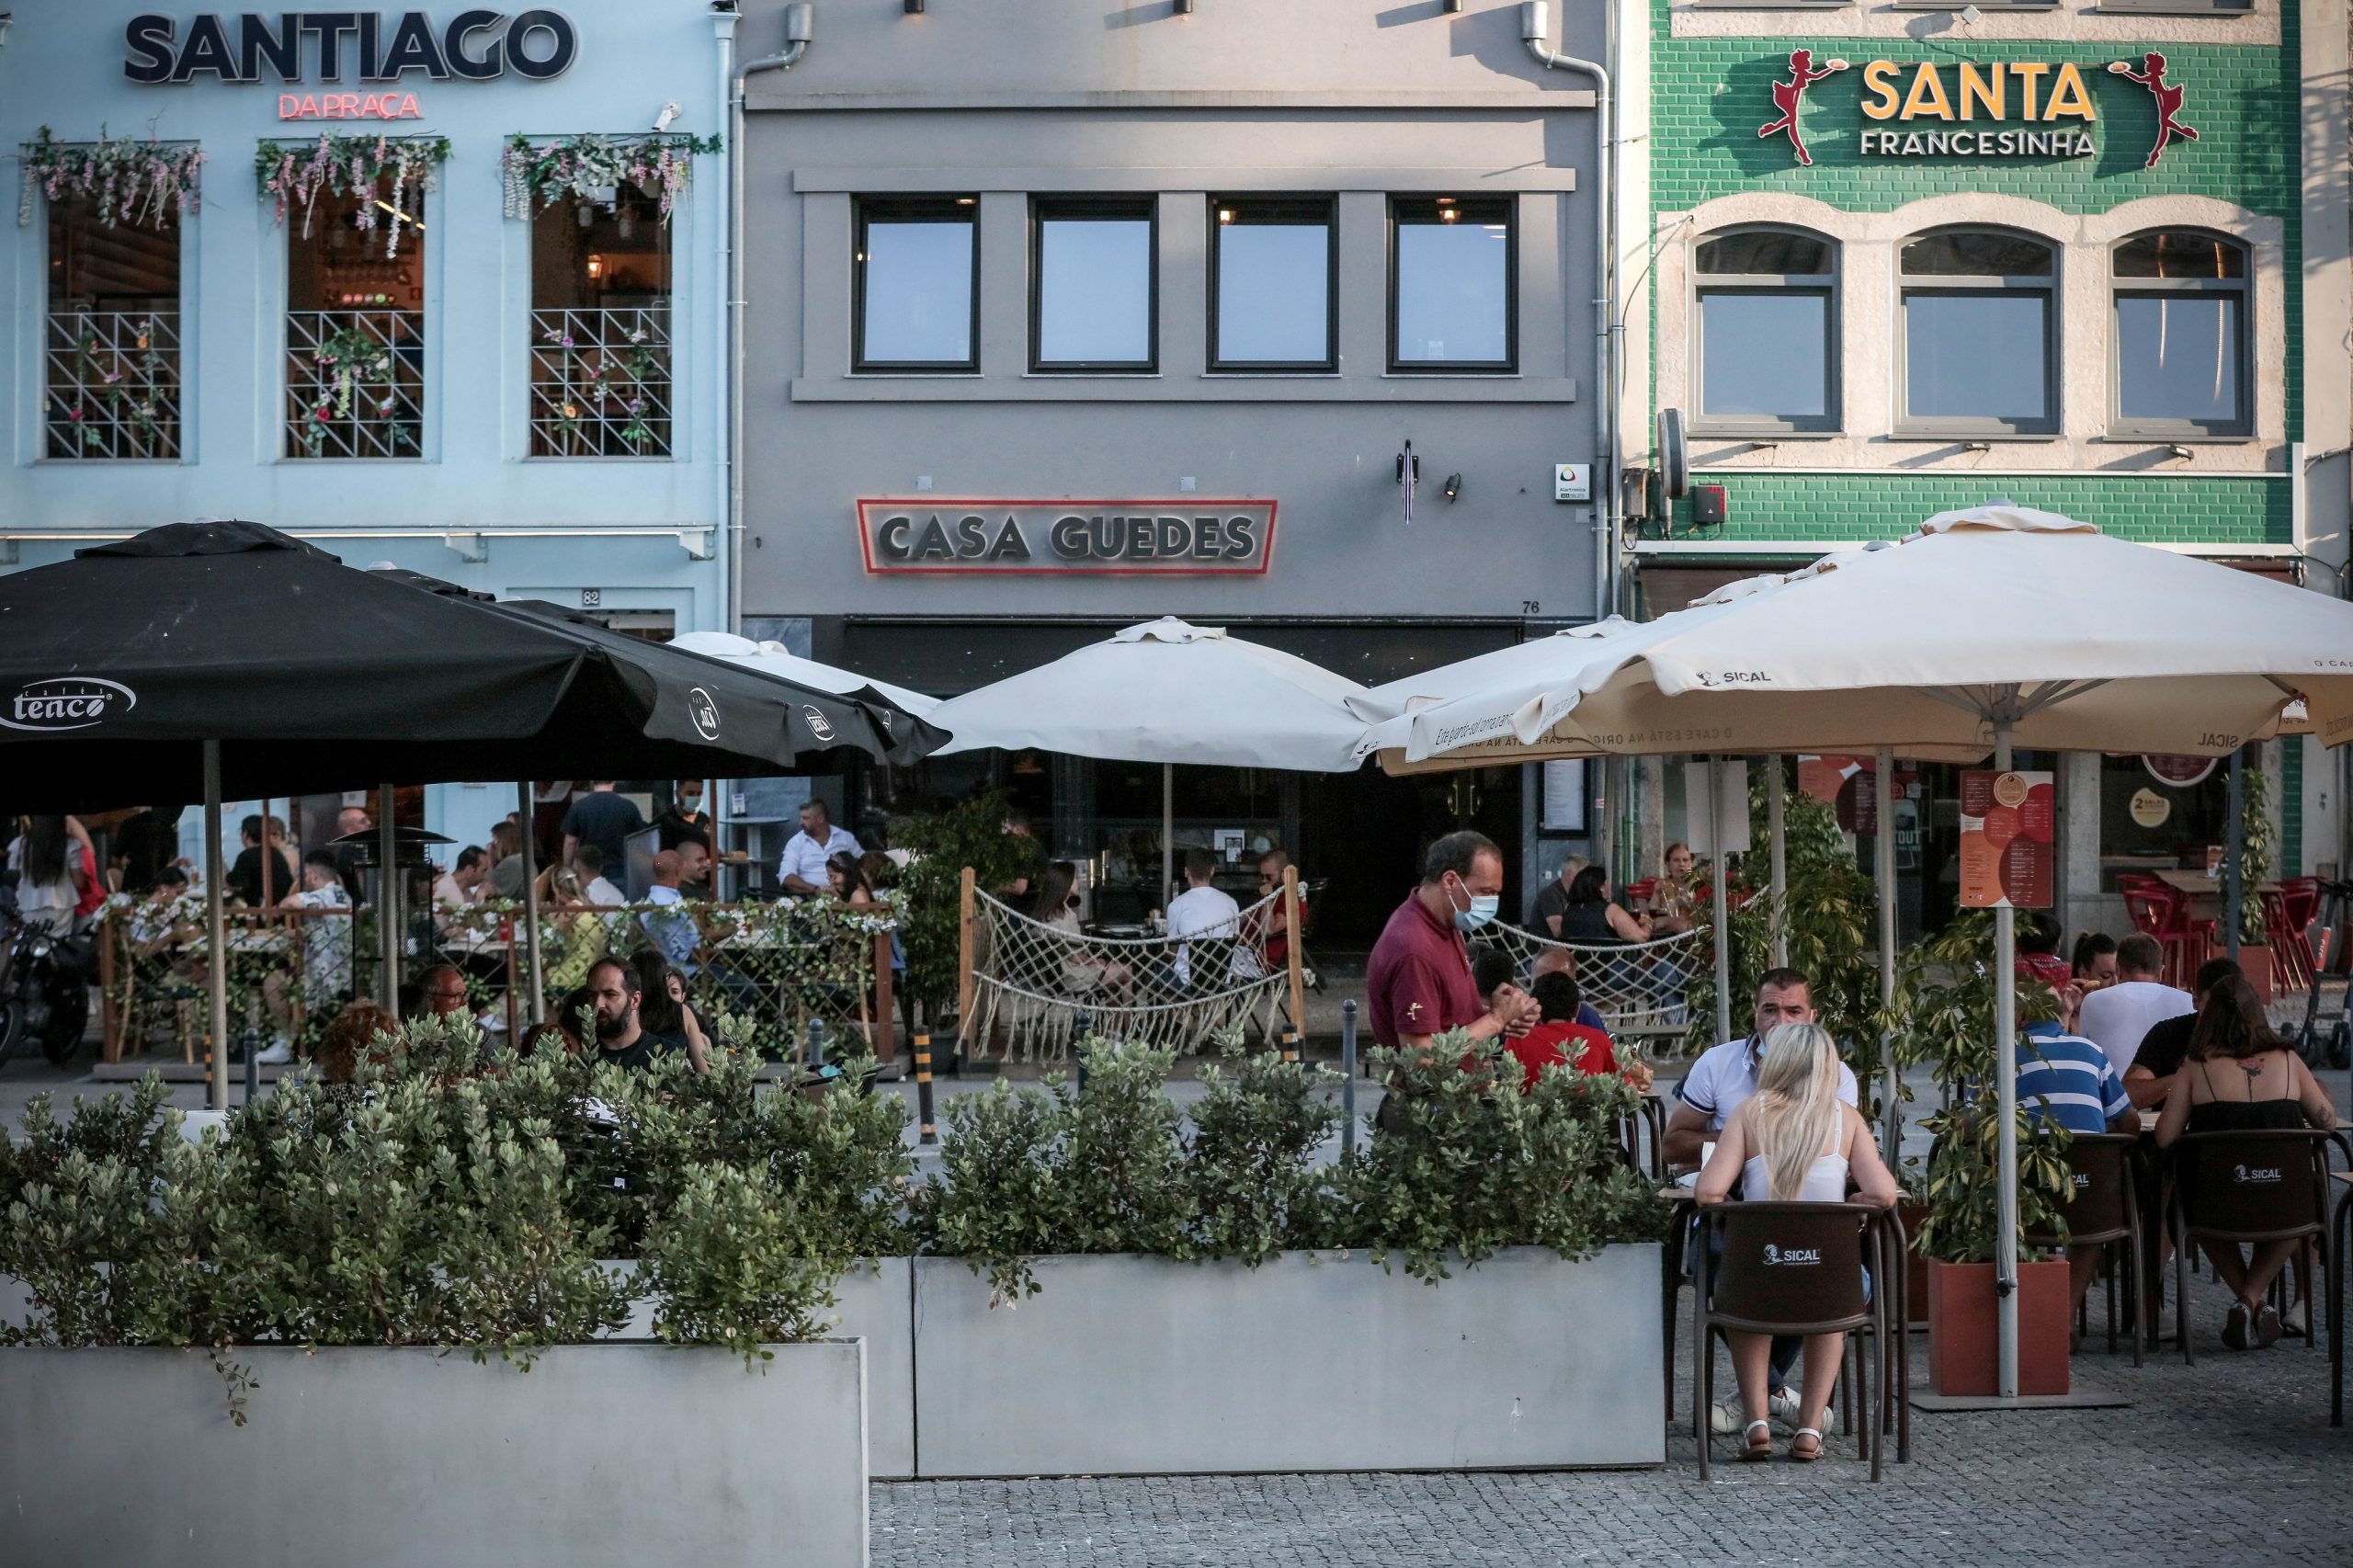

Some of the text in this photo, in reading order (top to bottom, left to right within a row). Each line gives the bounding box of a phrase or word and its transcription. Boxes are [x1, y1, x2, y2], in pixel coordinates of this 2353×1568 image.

[125, 9, 576, 84] SANTIAGO
[1860, 60, 2097, 121] SANTA
[278, 94, 420, 119] DA PRAÇA
[1860, 131, 2097, 156] FRANCESINHA
[879, 514, 1256, 559] CASA GUEDES
[583, 591, 599, 605] 82
[1522, 600, 1540, 614] 76
[1723, 671, 1772, 683] SICAL
[25, 687, 103, 697] cafés
[14, 693, 105, 720] tenco
[1894, 830, 1922, 845] OUT
[2072, 1174, 2089, 1185] CAL
[2251, 1168, 2282, 1179] SICAL
[1784, 1249, 1820, 1261] SICAL
